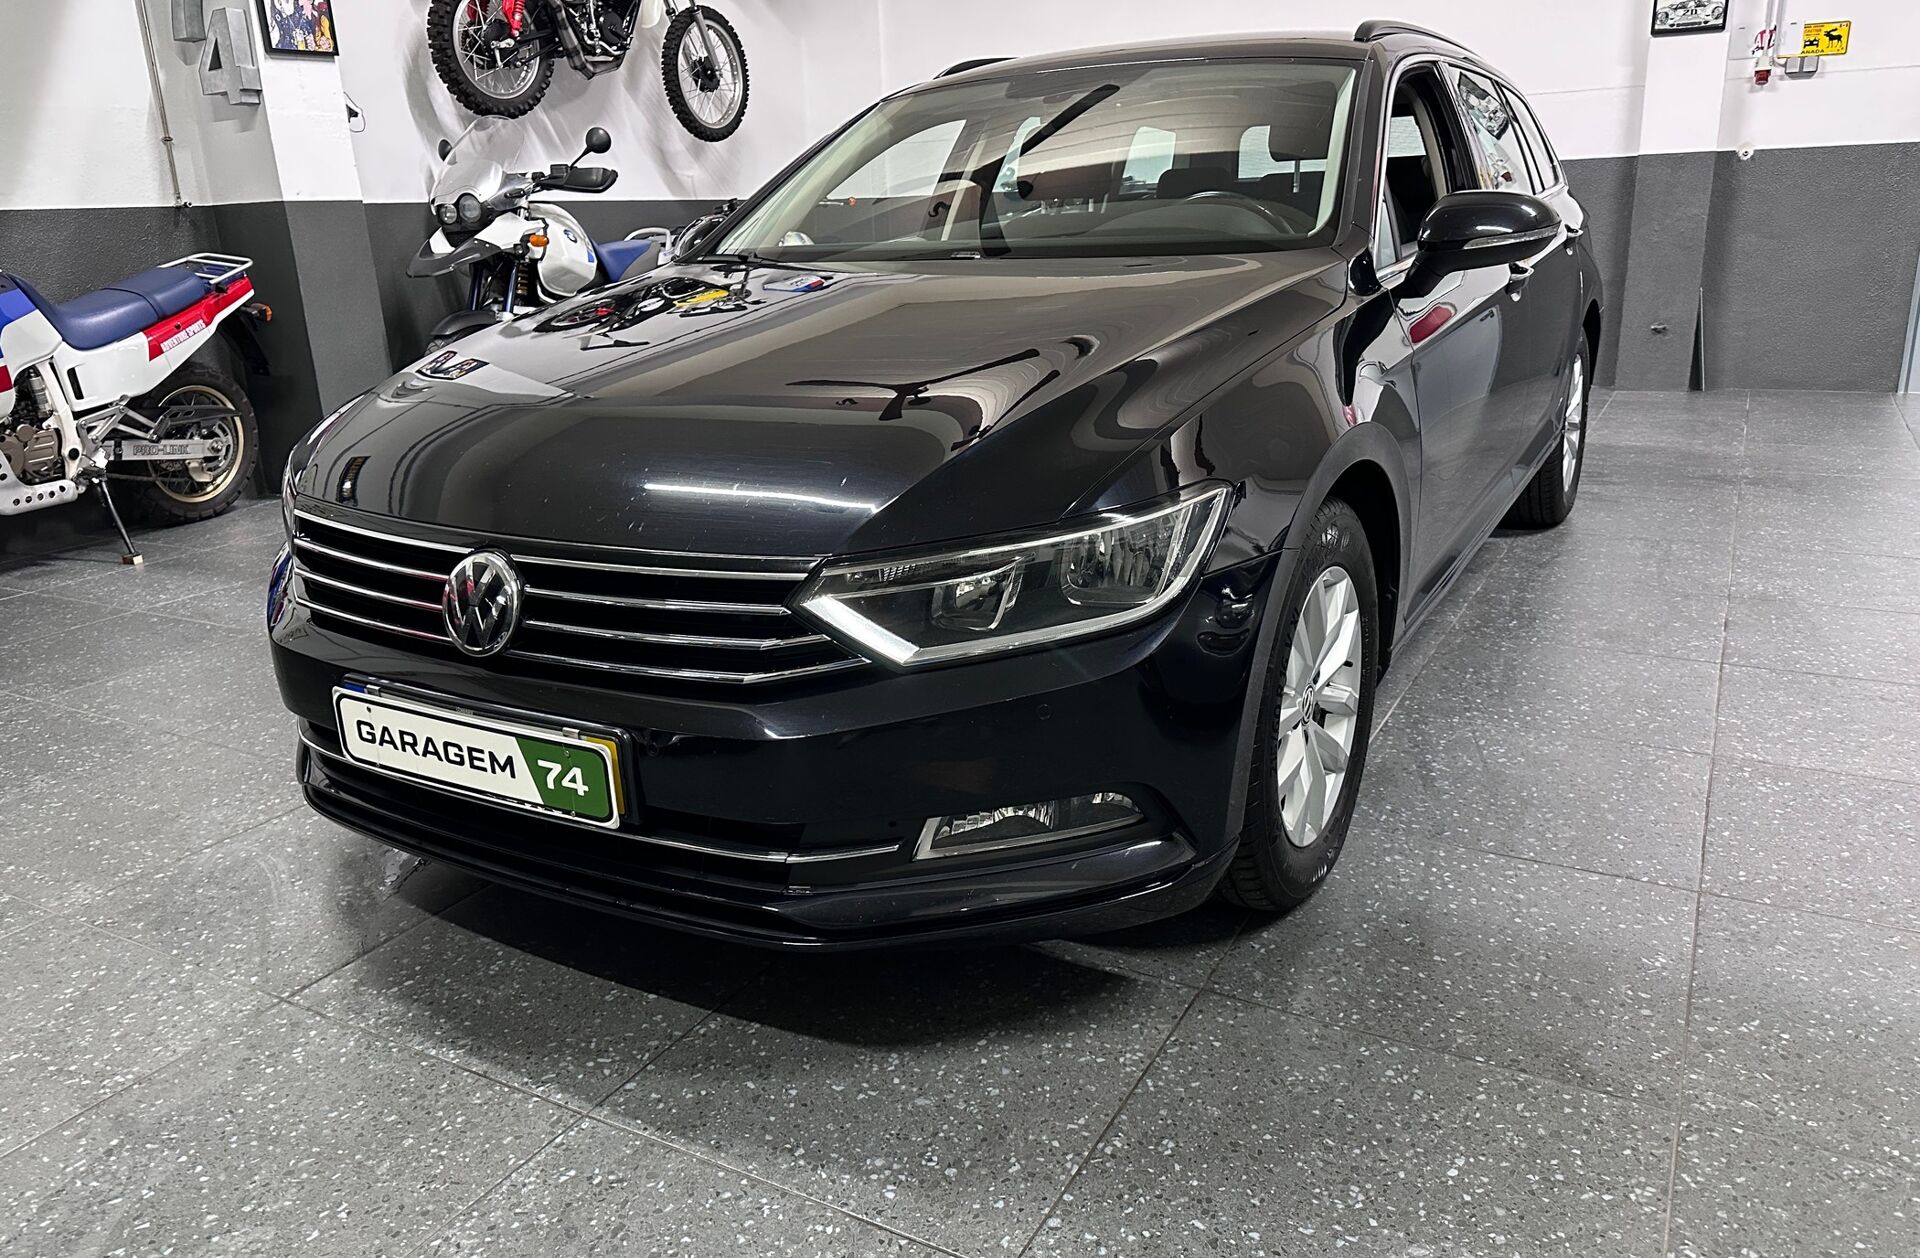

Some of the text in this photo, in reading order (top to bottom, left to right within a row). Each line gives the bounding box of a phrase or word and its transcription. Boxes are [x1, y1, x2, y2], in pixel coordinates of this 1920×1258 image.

[132, 444, 191, 456] PRO-LINK
[356, 719, 590, 797] GARAGEM 74
